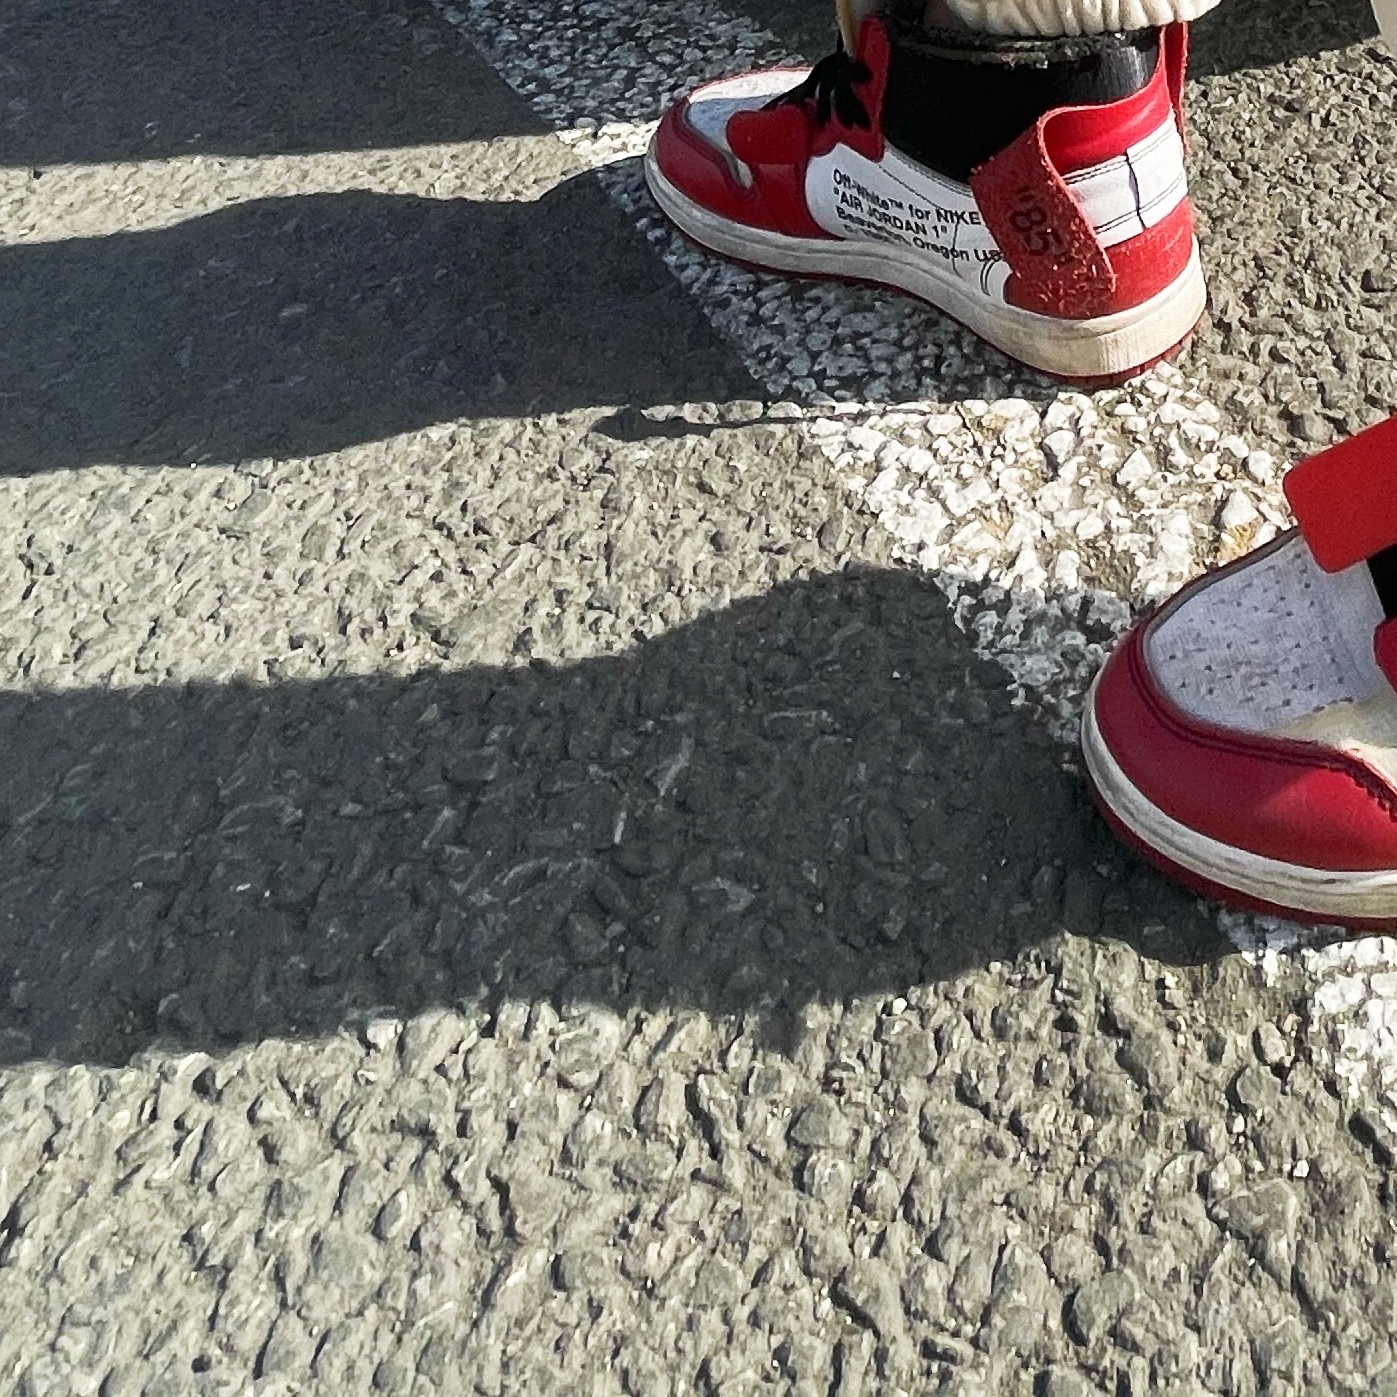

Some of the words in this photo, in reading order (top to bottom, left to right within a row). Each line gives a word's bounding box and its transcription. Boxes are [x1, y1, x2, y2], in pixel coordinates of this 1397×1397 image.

[867, 204, 927, 236] JORDAN
[908, 203, 931, 221] for
[935, 208, 982, 226] NIKE
[912, 236, 970, 262] Oregon
